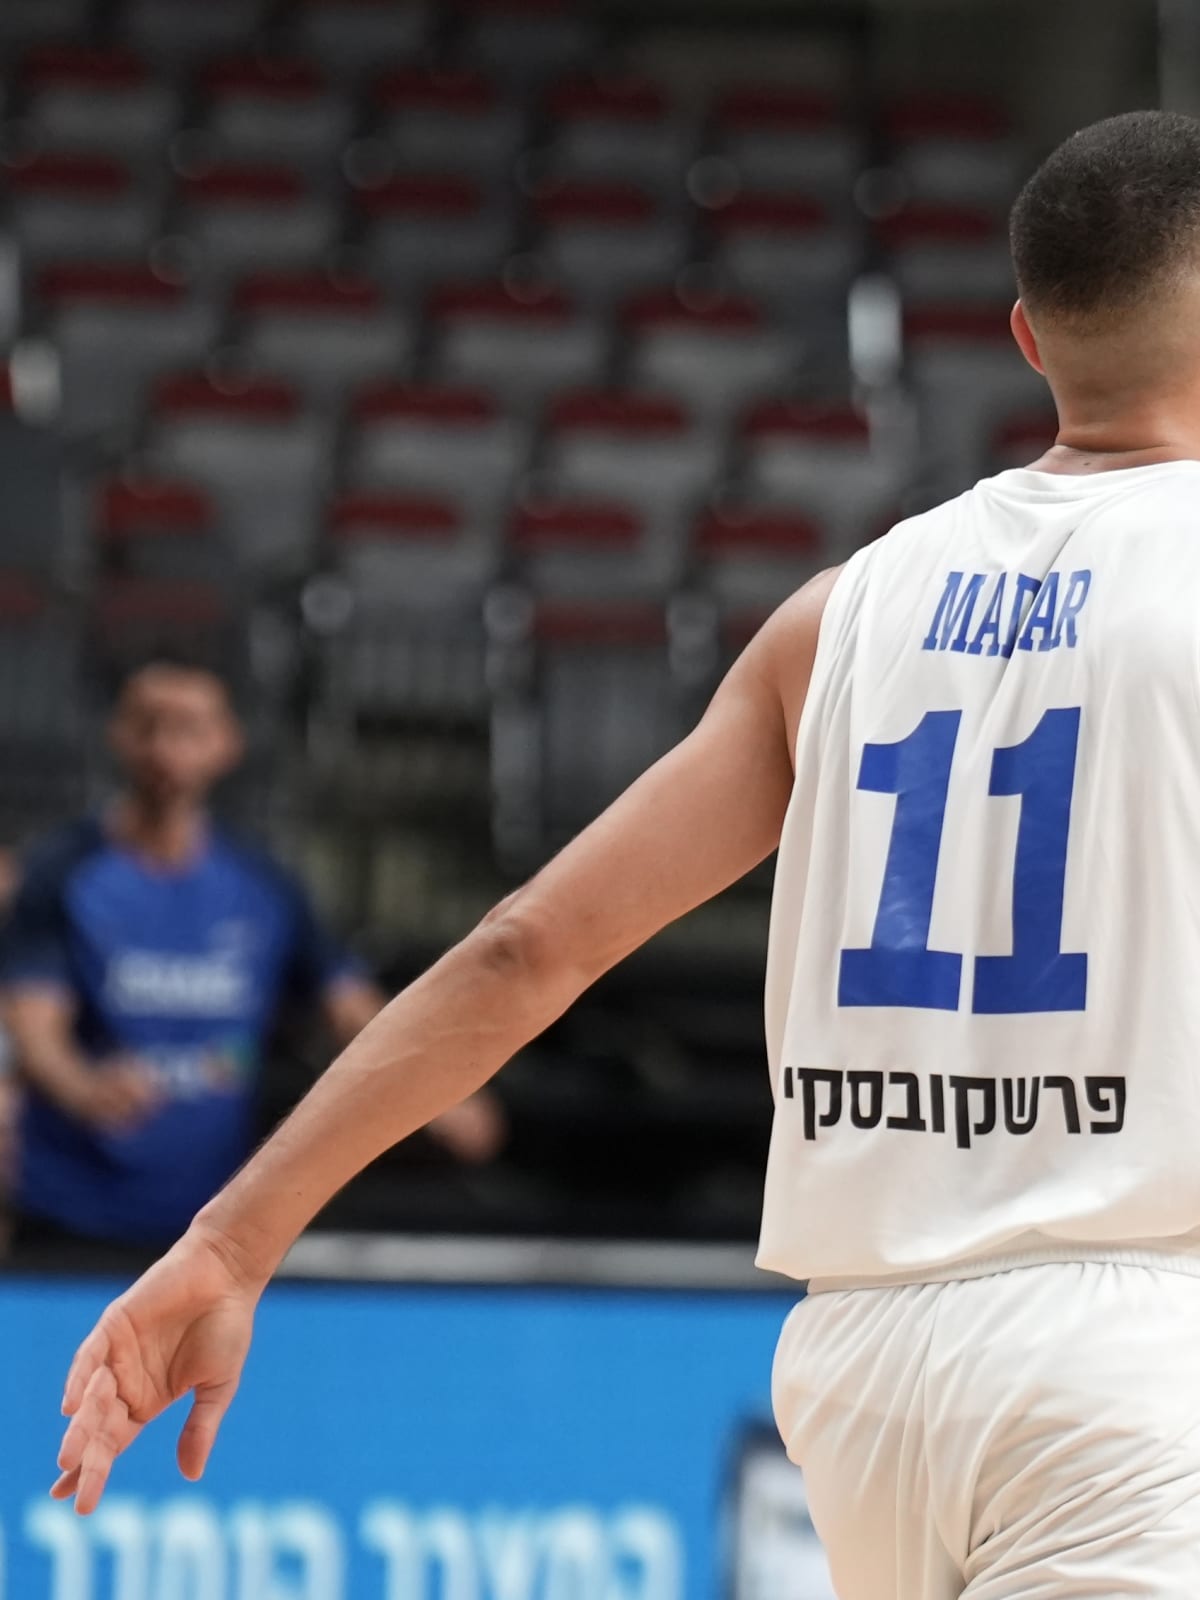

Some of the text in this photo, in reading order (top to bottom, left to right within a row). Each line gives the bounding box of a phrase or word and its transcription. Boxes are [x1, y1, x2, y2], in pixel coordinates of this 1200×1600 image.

[922, 569, 1092, 659] MADAR
[838, 706, 1088, 1014] 11
[784, 1066, 1126, 1149] פרשקובסקי
